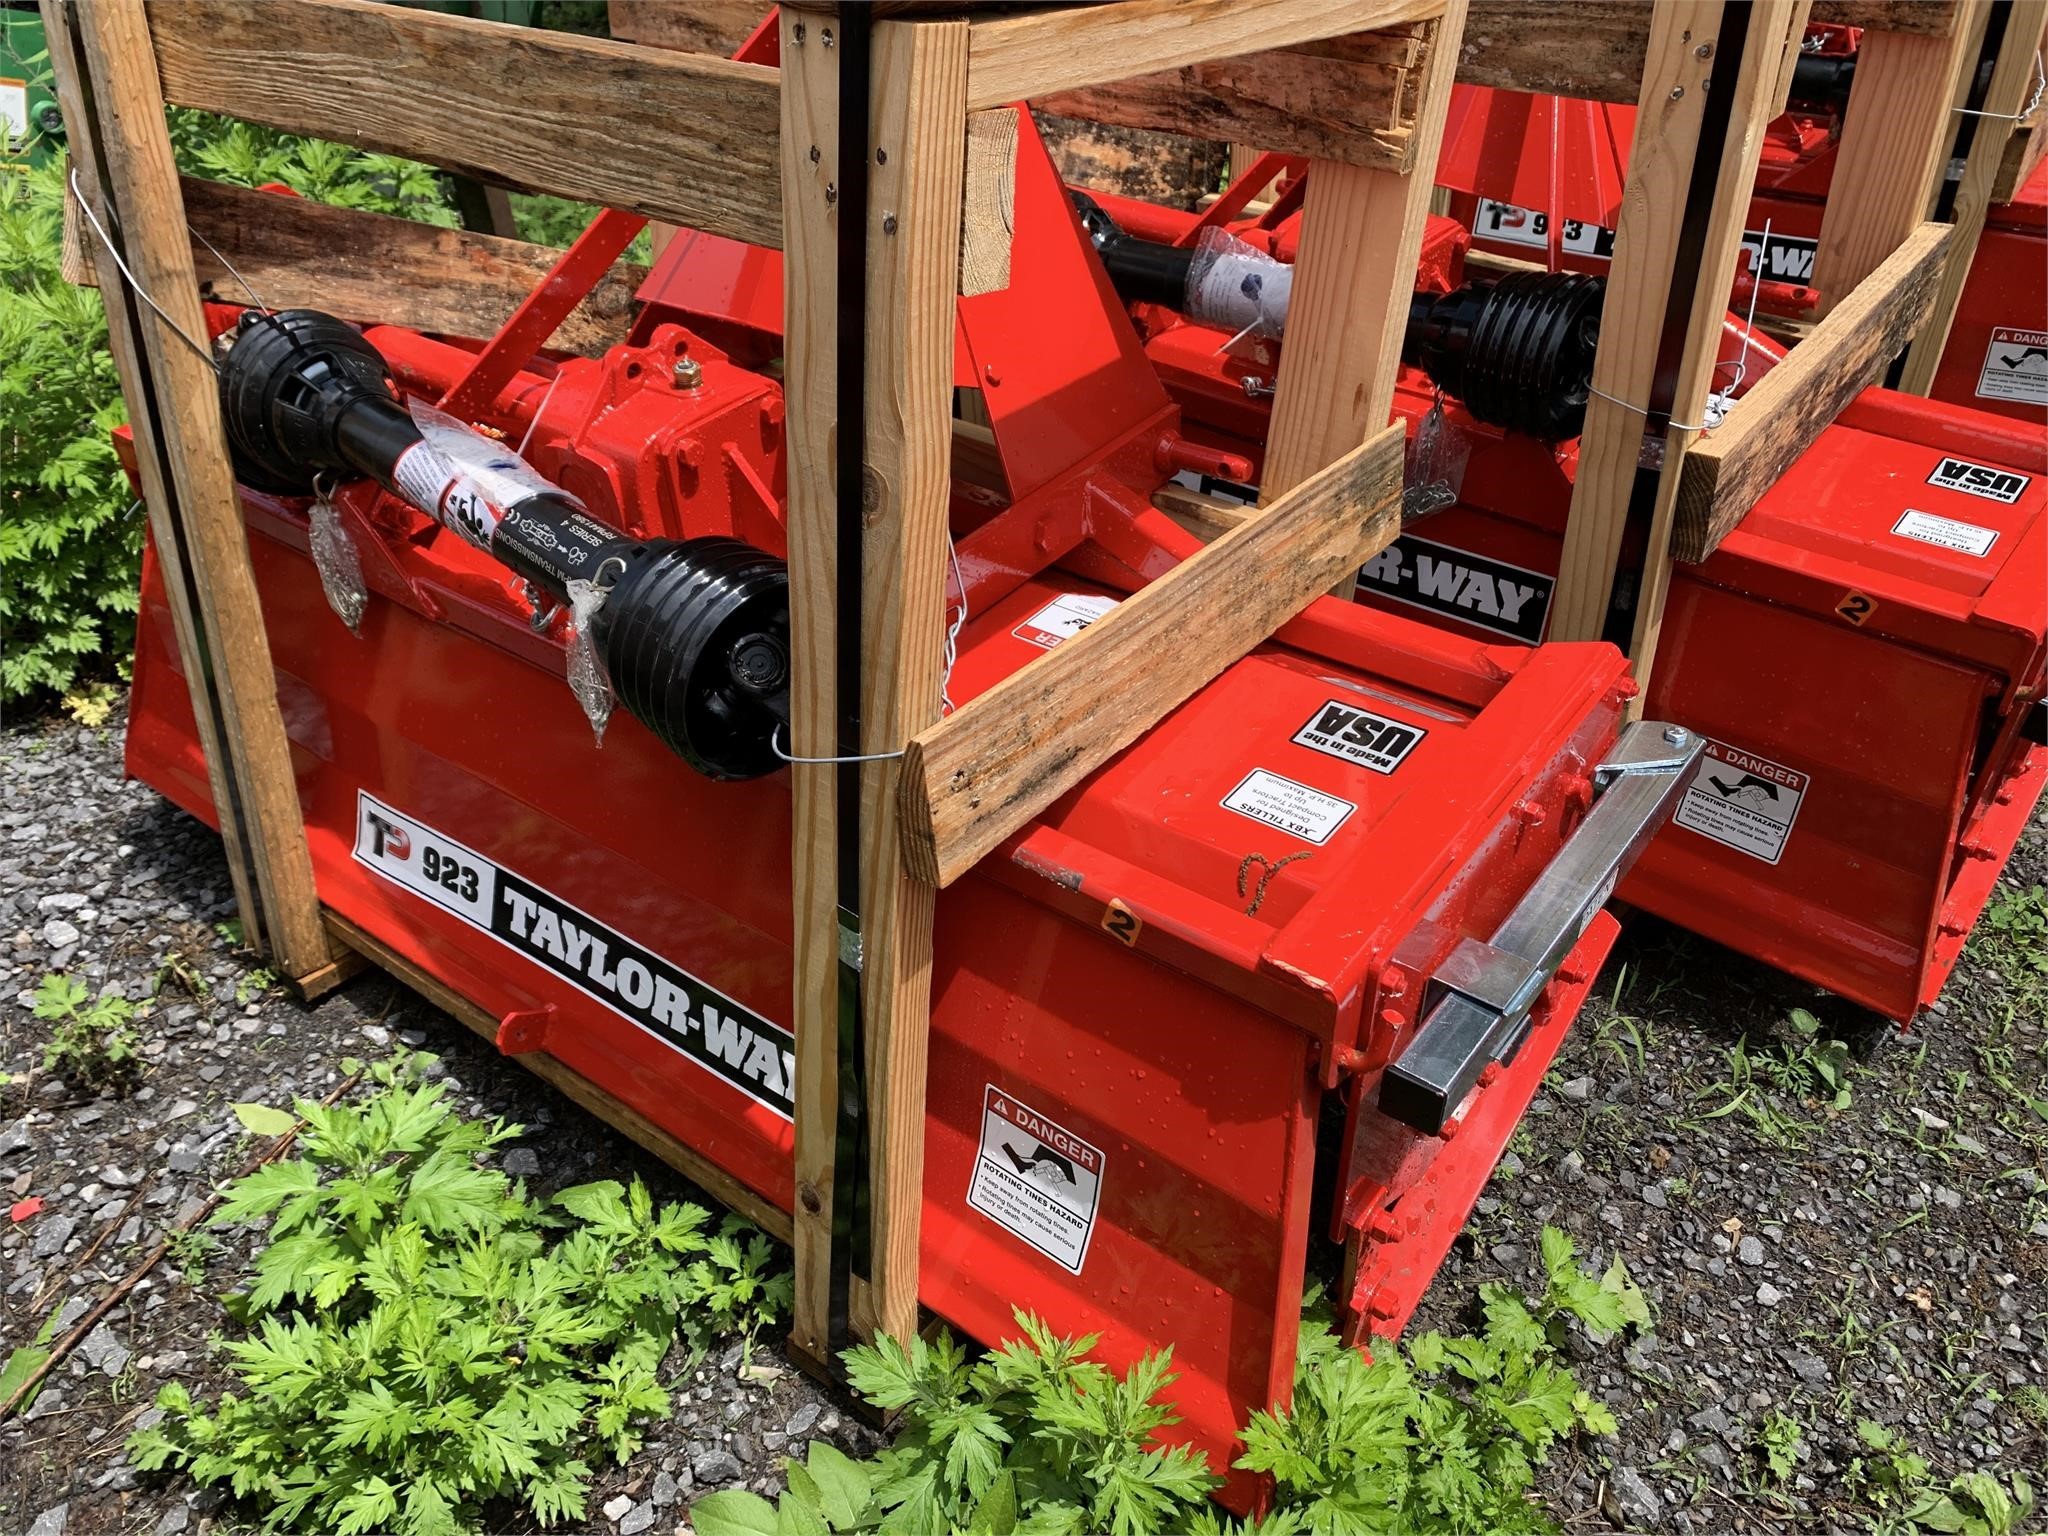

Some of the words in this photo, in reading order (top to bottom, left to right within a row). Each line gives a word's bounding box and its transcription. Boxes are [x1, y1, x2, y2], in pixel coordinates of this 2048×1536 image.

[1532, 213, 1583, 240] 93
[1934, 477, 1957, 486] the
[1941, 461, 2023, 494] USA
[1973, 486, 2011, 500] Made
[560, 519, 570, 527] 4
[568, 525, 603, 547] SERIES
[495, 528, 557, 577] TRANSMISSIONS
[1840, 596, 1871, 622] 2
[1303, 731, 1329, 746] the
[1314, 705, 1415, 758] USA
[1330, 740, 1345, 750] in
[1346, 747, 1391, 768] Made
[1725, 751, 1799, 787] DANGER
[1252, 787, 1286, 807] Tractors
[1266, 777, 1306, 796] Maximum
[1256, 798, 1268, 807] for
[1287, 802, 1327, 822] Compact
[1295, 795, 1308, 806] Up
[1690, 790, 1727, 809] ROTATING
[1729, 802, 1751, 819] TINES
[1752, 814, 1783, 832] HAZARD
[1240, 802, 1284, 825] TILLERS
[1270, 803, 1310, 824] Designed
[1685, 813, 1700, 824] injury
[1690, 800, 1704, 810] Keep
[1705, 806, 1719, 816] away
[1719, 811, 1732, 821] from
[1732, 817, 1754, 831] rotating
[1287, 822, 1315, 835] XBX
[1687, 808, 1711, 821] Rotating
[1711, 816, 1724, 826] tines
[1725, 822, 1737, 832] may
[1737, 828, 1753, 839] cause
[1754, 835, 1775, 847] serious
[422, 847, 479, 903] 923
[1107, 909, 1136, 942] 2
[1015, 1108, 1094, 1168] DANGER
[983, 1162, 1022, 1191] ROTATING
[1024, 1187, 1048, 1207] TINES
[1050, 1204, 1083, 1229] HAZARD
[984, 1176, 999, 1189] Keep
[999, 1187, 1017, 1200] away
[1014, 1194, 1029, 1207] from
[1029, 1203, 1052, 1225] rotating
[1053, 1220, 1069, 1235] tines.
[979, 1192, 996, 1208] injury
[1003, 1207, 1022, 1224] death.
[981, 1186, 1006, 1206] Rotating
[1006, 1200, 1021, 1215] tines
[1021, 1211, 1034, 1224] may
[1034, 1219, 1053, 1235] cause
[1053, 1231, 1076, 1249] serious
